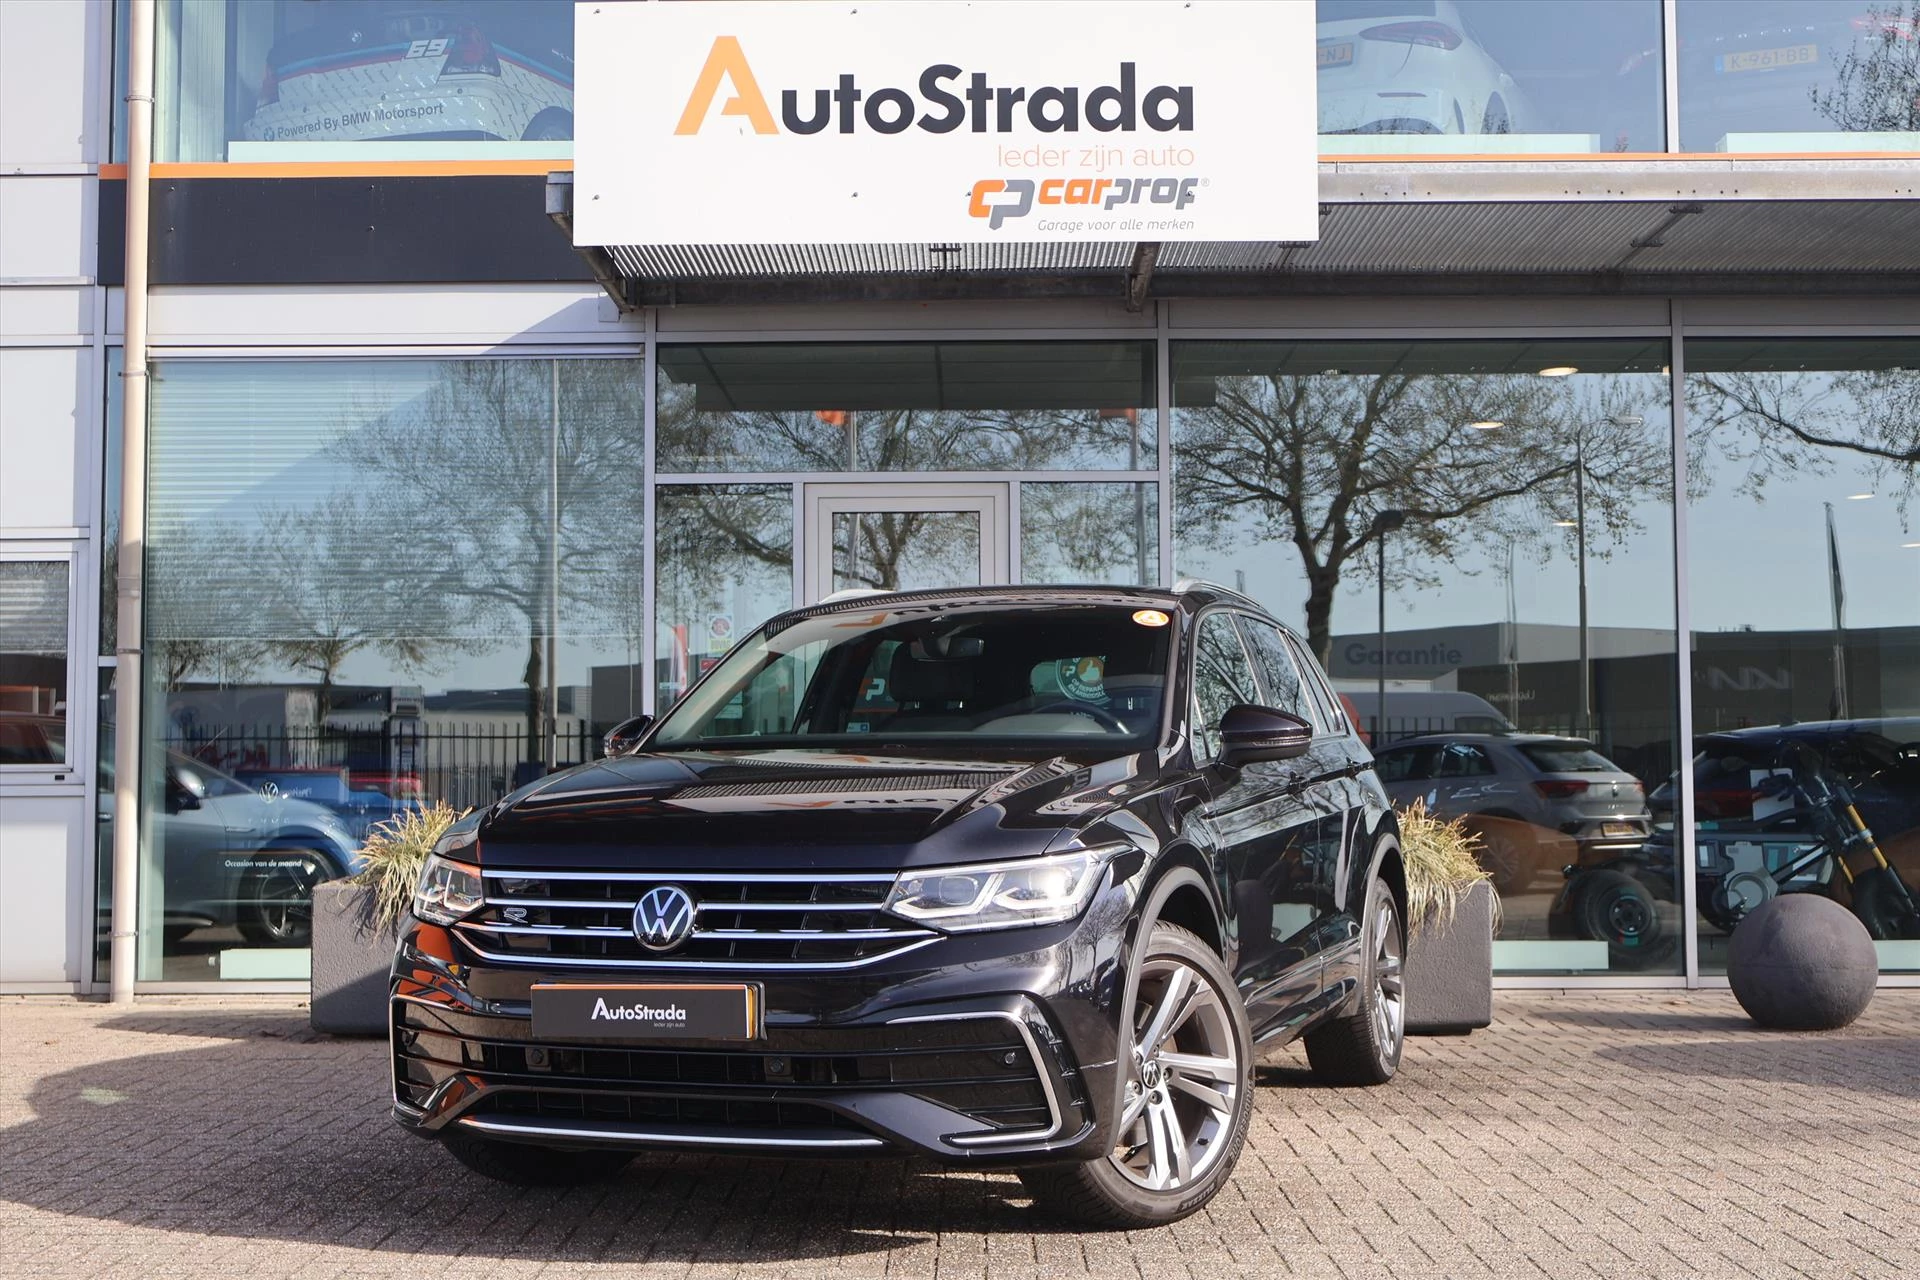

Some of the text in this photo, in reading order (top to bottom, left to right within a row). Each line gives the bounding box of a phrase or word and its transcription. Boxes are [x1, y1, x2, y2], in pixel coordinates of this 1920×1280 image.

[405, 38, 449, 58] 69
[673, 35, 1195, 136] AutoStrada
[277, 103, 445, 139] Powered By BMW Motorsport
[997, 144, 1195, 173] Ieder zijn auto
[1037, 177, 1199, 211] carprof
[1037, 218, 1195, 234] Garage voor alle merken
[1344, 643, 1463, 666] Garantie
[225, 859, 303, 868] Occasion van de maand
[591, 997, 687, 1021] AutoStrada
